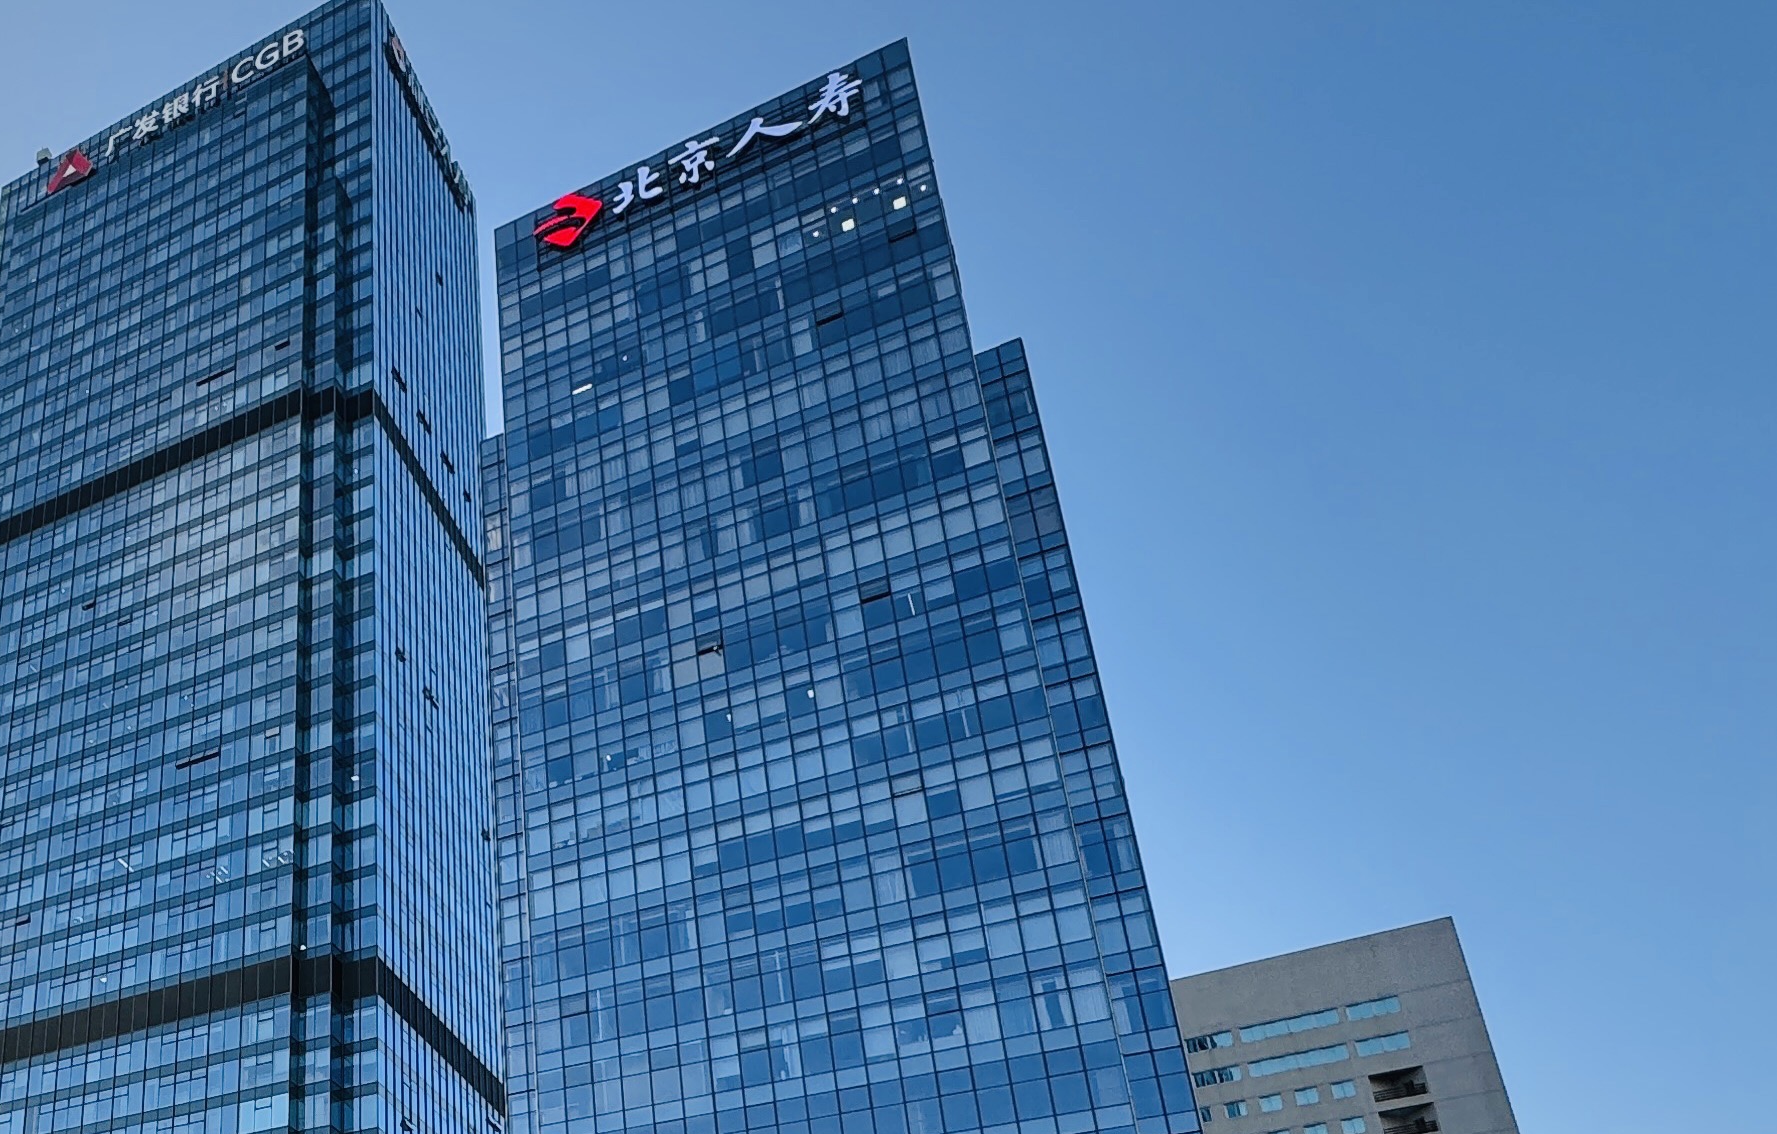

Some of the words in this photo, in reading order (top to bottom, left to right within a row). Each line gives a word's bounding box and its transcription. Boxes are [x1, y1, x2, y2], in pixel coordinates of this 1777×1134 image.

[104, 75, 222, 158] 广发银行
[230, 29, 306, 84] CGB
[613, 72, 863, 214] 北京人寿
